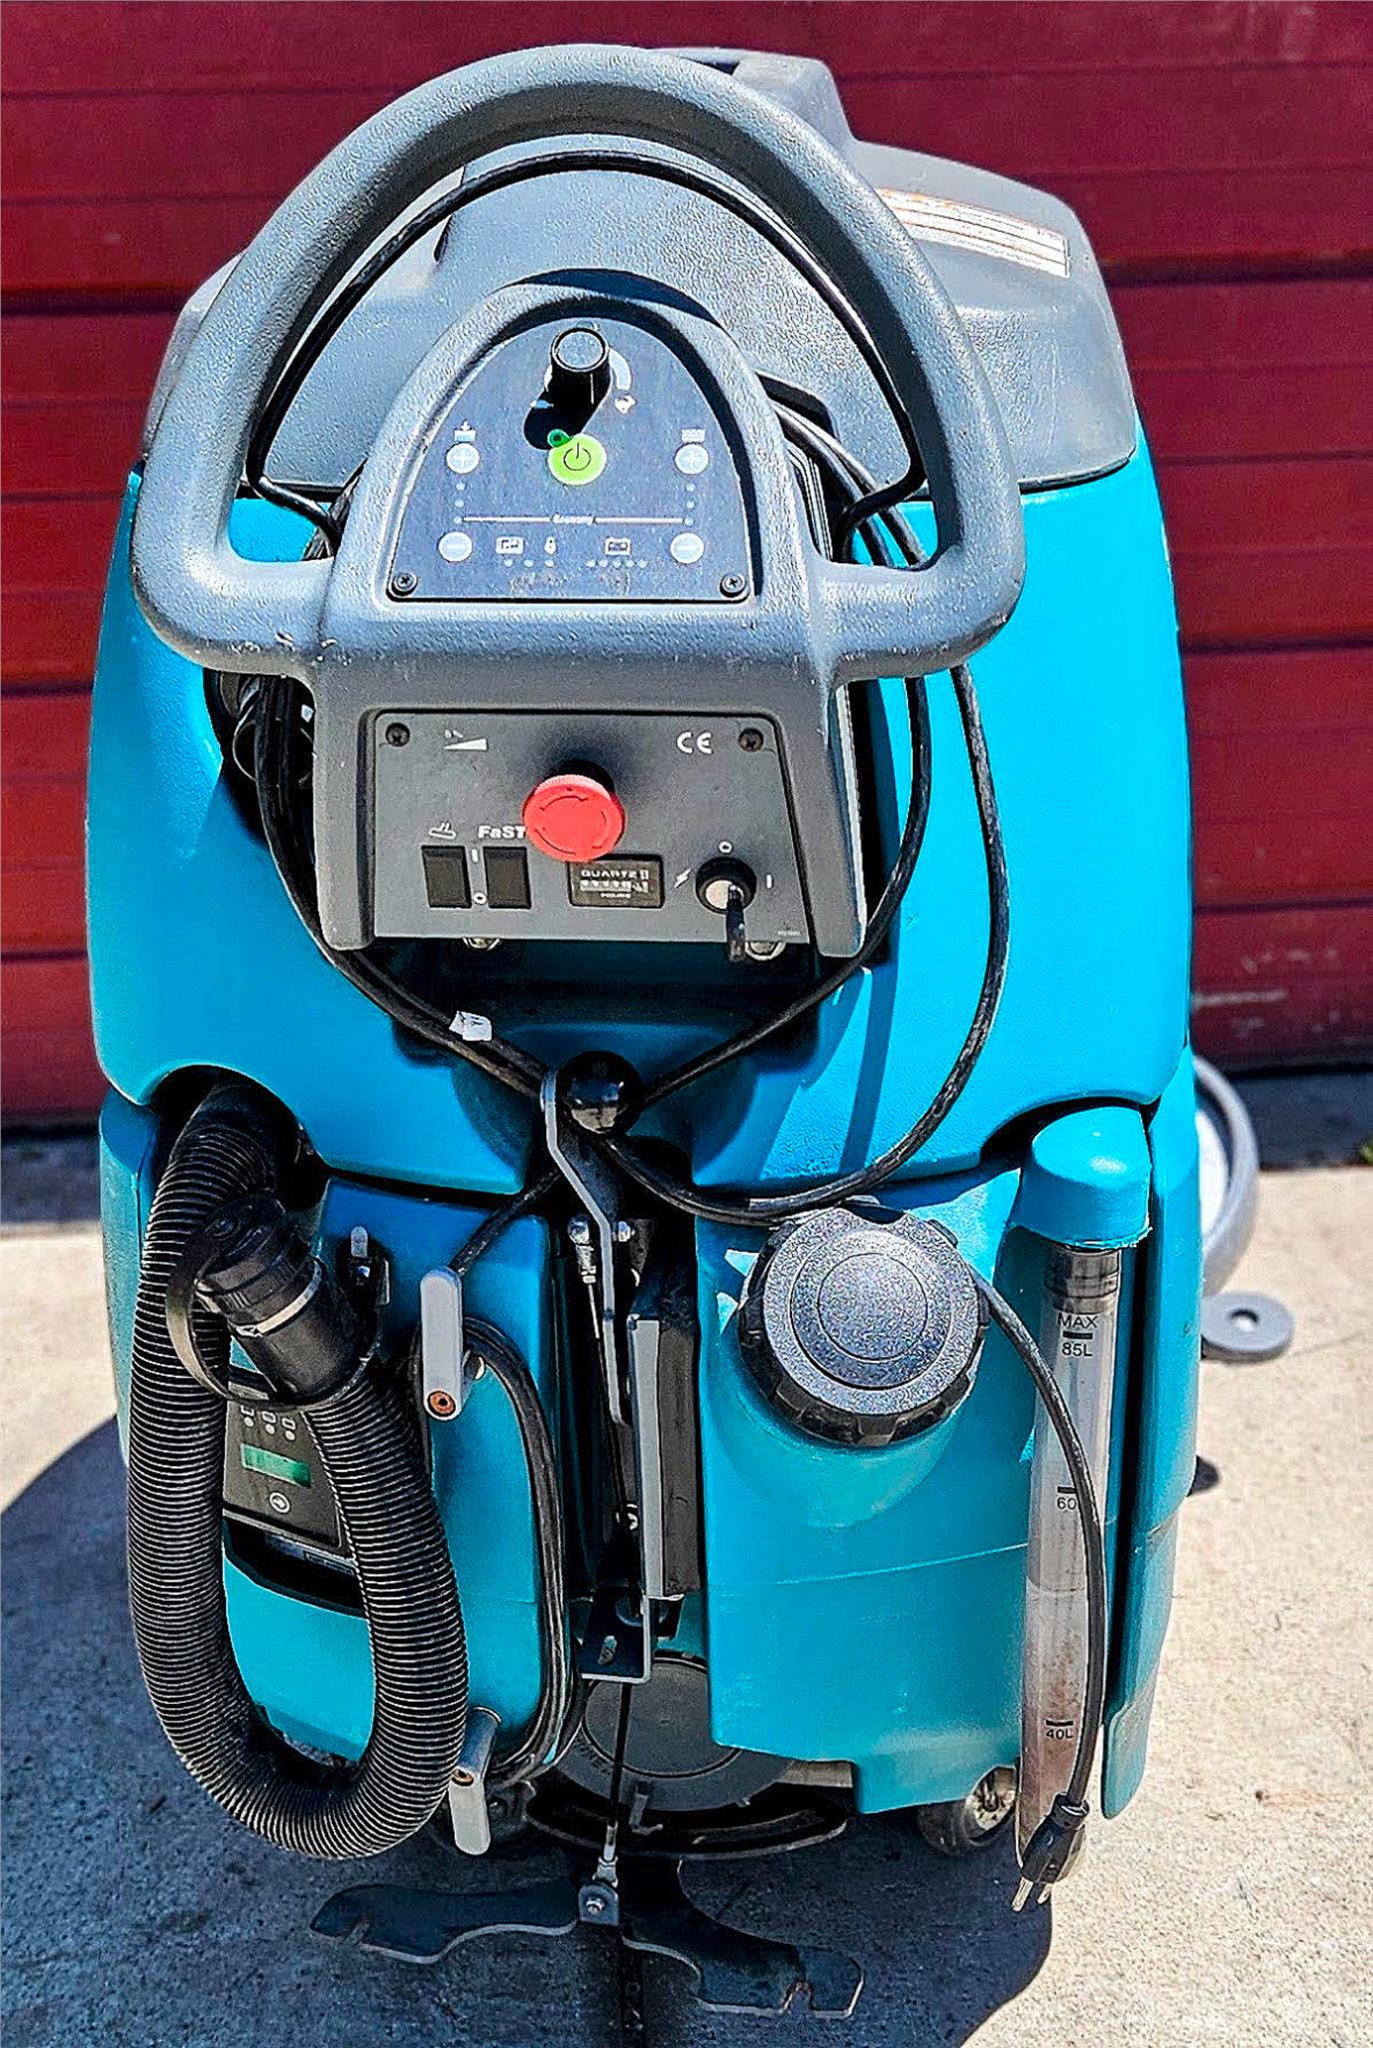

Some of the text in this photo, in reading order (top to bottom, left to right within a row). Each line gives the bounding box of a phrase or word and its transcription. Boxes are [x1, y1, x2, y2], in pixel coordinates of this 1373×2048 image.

[676, 731, 713, 754] CE
[1057, 1312, 1098, 1329] MAX
[1062, 1342, 1093, 1357] 85L
[1046, 1729, 1074, 1740] 40L
